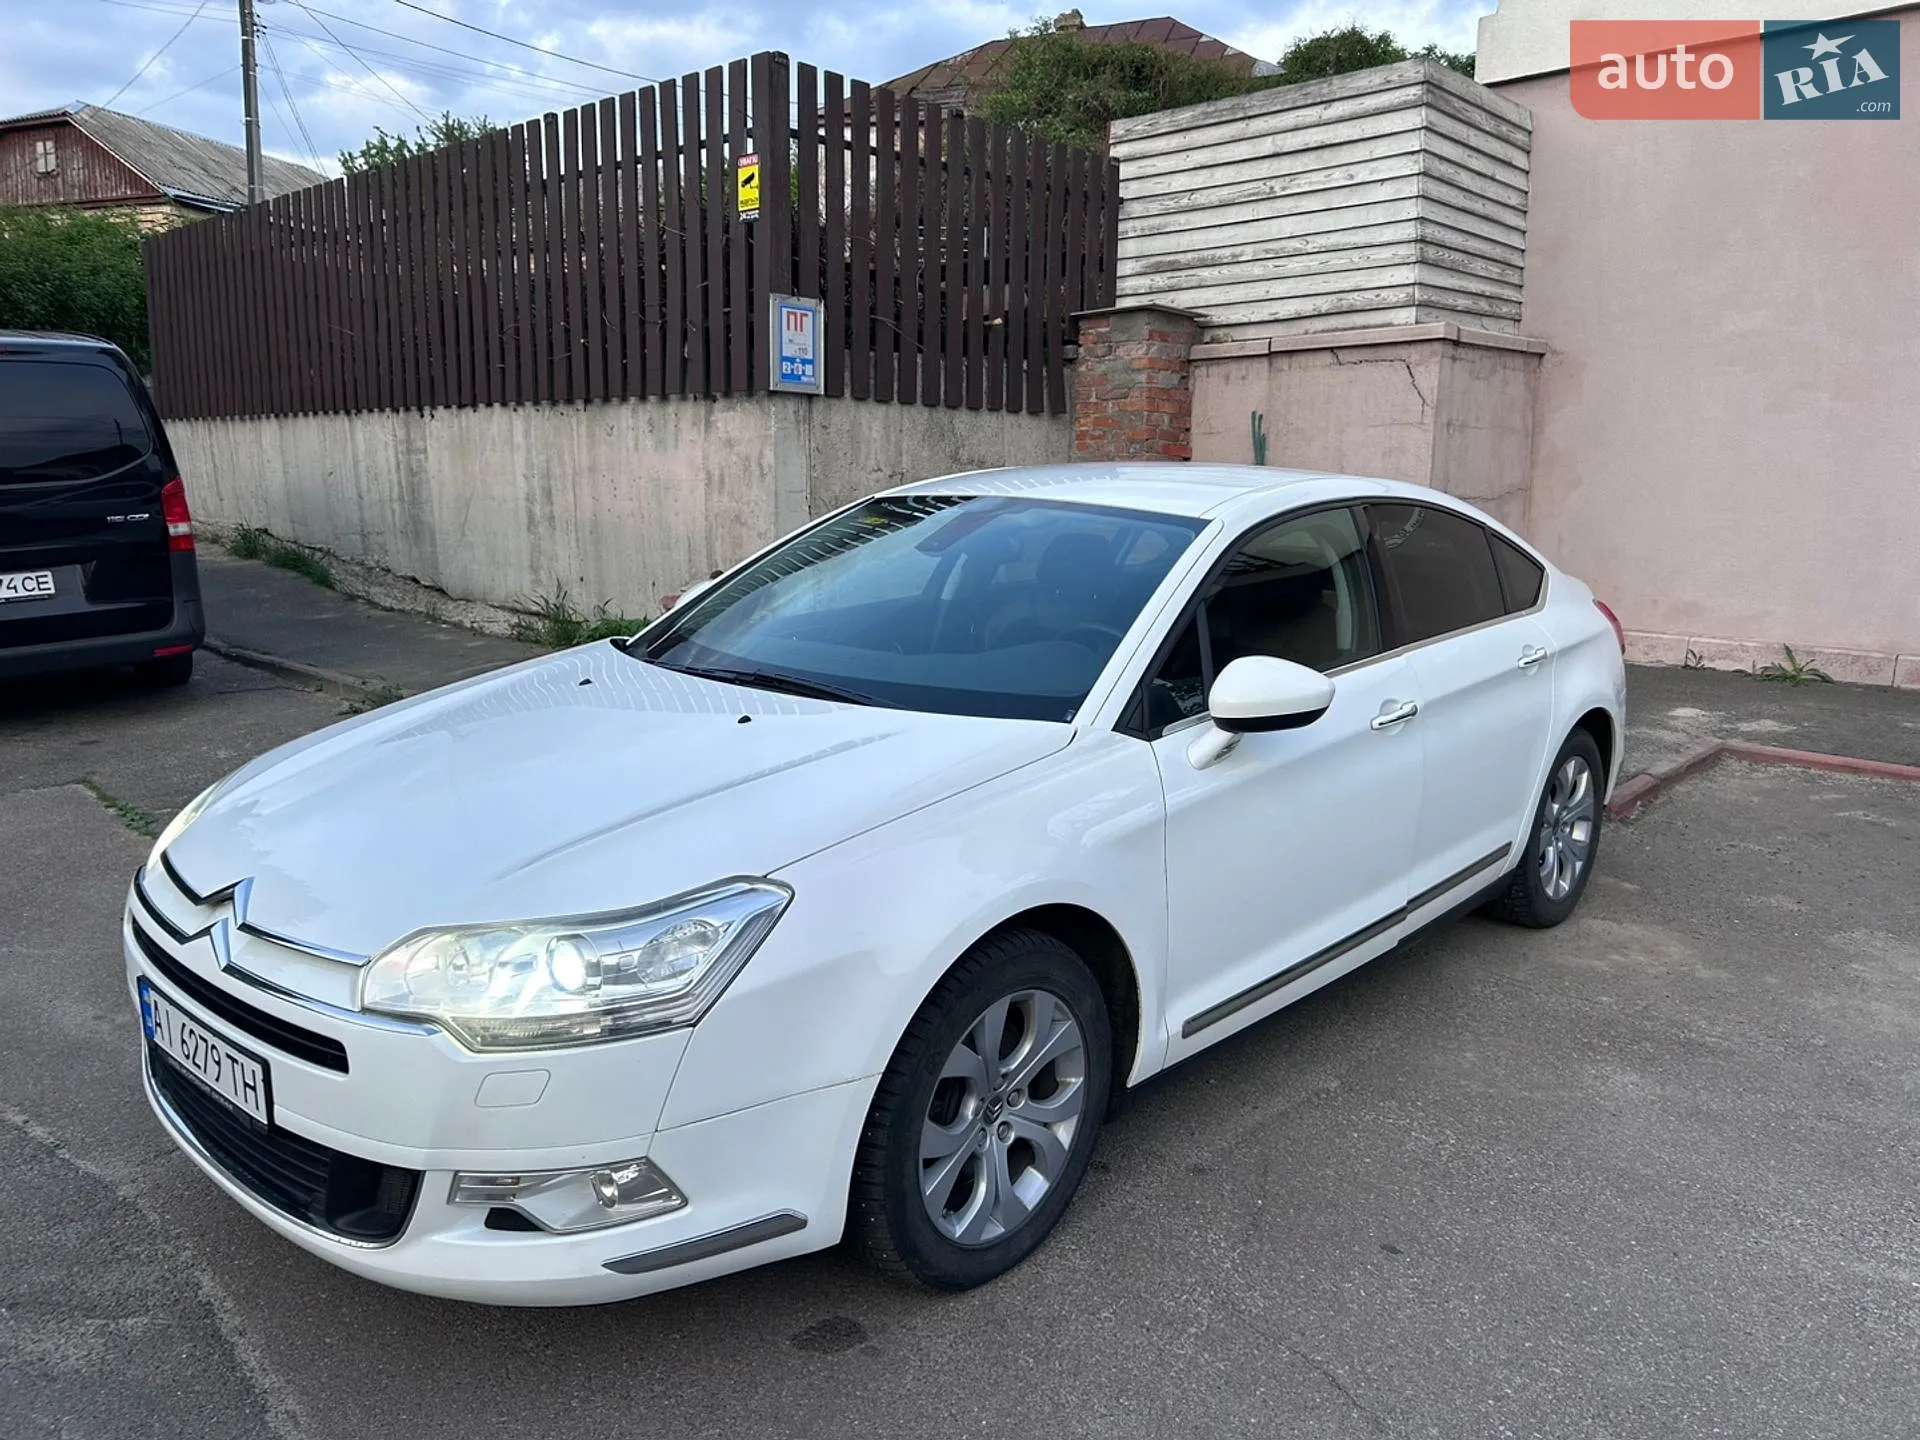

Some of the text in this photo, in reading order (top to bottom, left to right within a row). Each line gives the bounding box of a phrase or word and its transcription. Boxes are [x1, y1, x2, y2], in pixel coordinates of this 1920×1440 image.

[786, 311, 809, 332] ПГ
[22, 574, 51, 592] CE
[154, 1000, 260, 1111] AI 6279 TH
